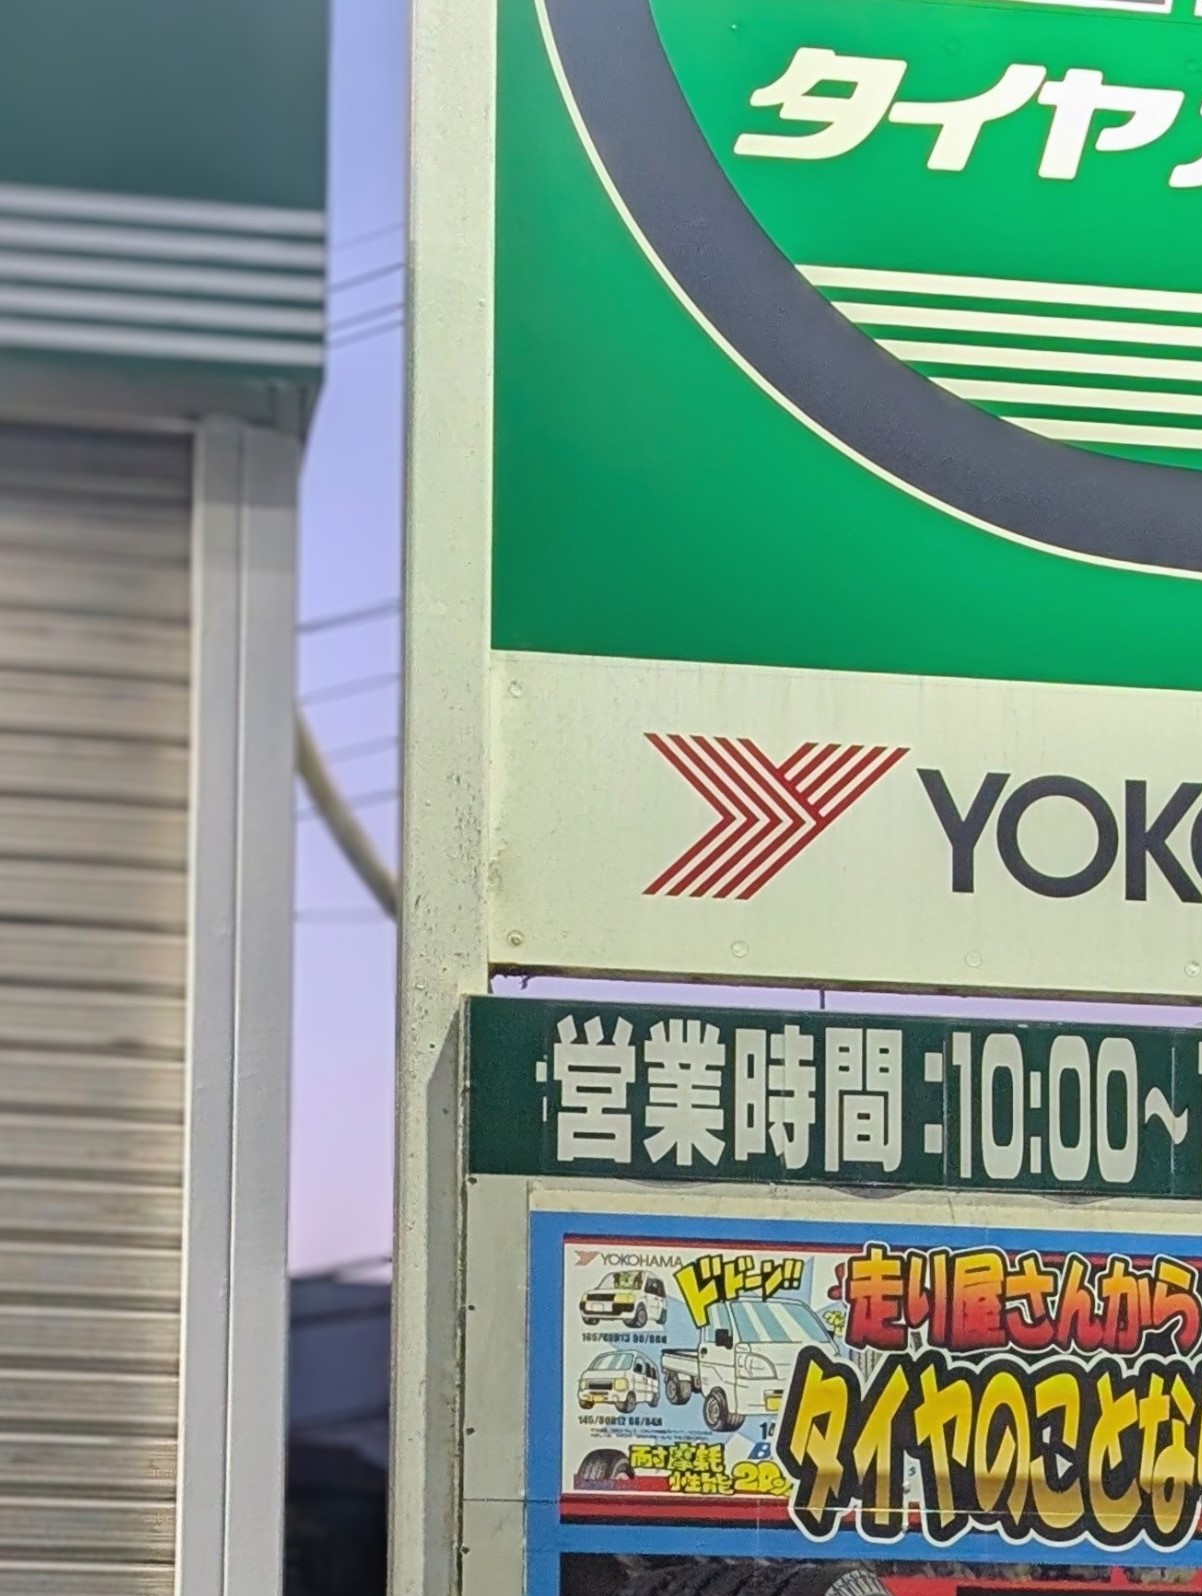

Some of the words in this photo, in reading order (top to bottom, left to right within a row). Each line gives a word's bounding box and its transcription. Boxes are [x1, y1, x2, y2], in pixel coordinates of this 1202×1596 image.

[600, 1252, 684, 1268] YOKOHAMA
[848, 1246, 1198, 1353] 走り屋さんから
